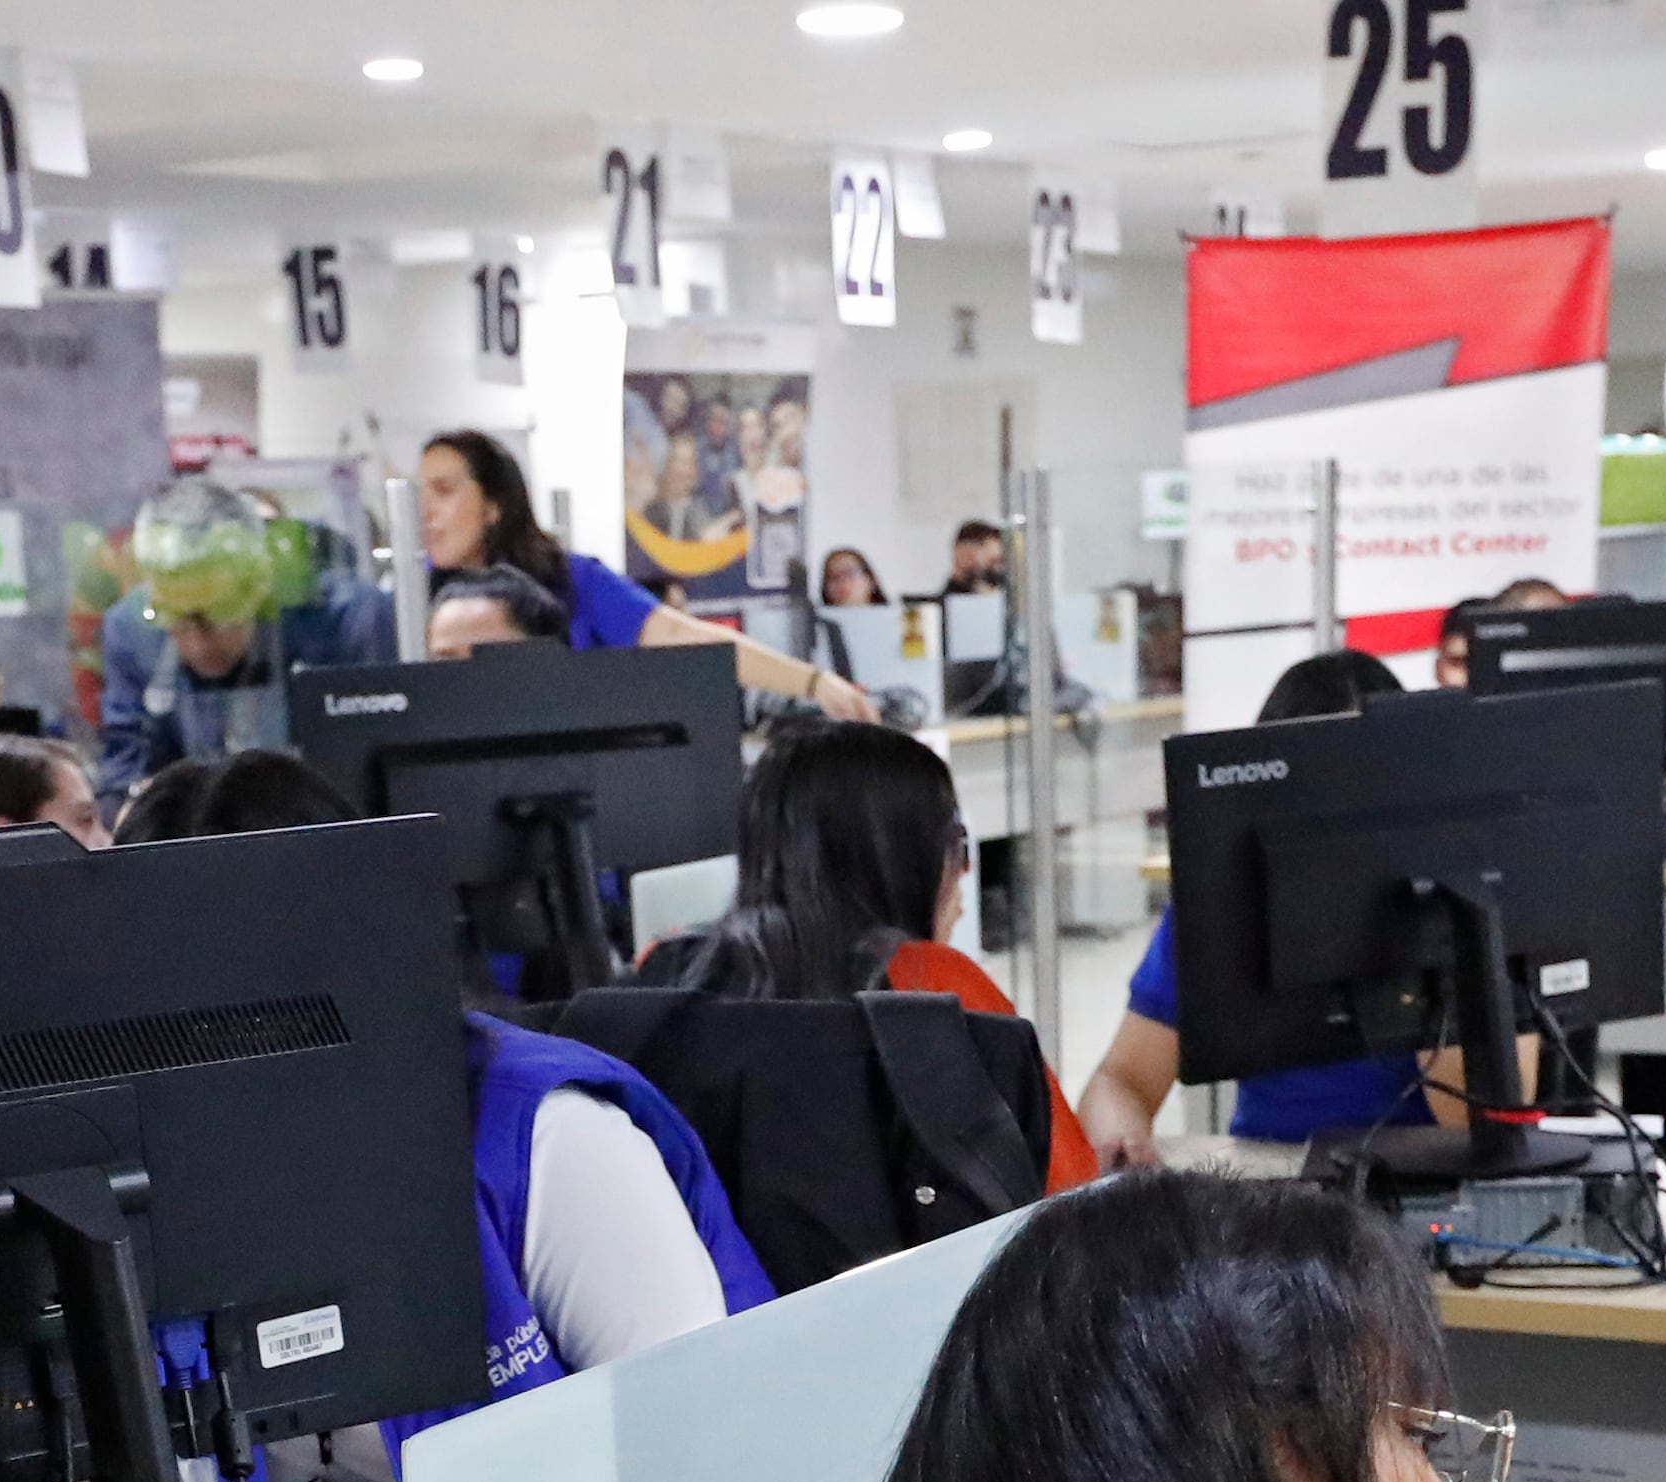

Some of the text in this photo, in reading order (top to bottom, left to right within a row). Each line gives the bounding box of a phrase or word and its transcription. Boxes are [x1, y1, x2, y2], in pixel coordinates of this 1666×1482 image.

[1325, 0, 1474, 181] 25
[604, 149, 661, 288] 21
[836, 174, 886, 296] 22
[1033, 190, 1076, 303] 23
[284, 245, 346, 349] 15
[473, 262, 521, 358] 16
[1235, 537, 1297, 563] BPO
[1450, 530, 1549, 556] Center
[325, 692, 409, 716] Lenovo
[1198, 756, 1289, 788] Lenovo
